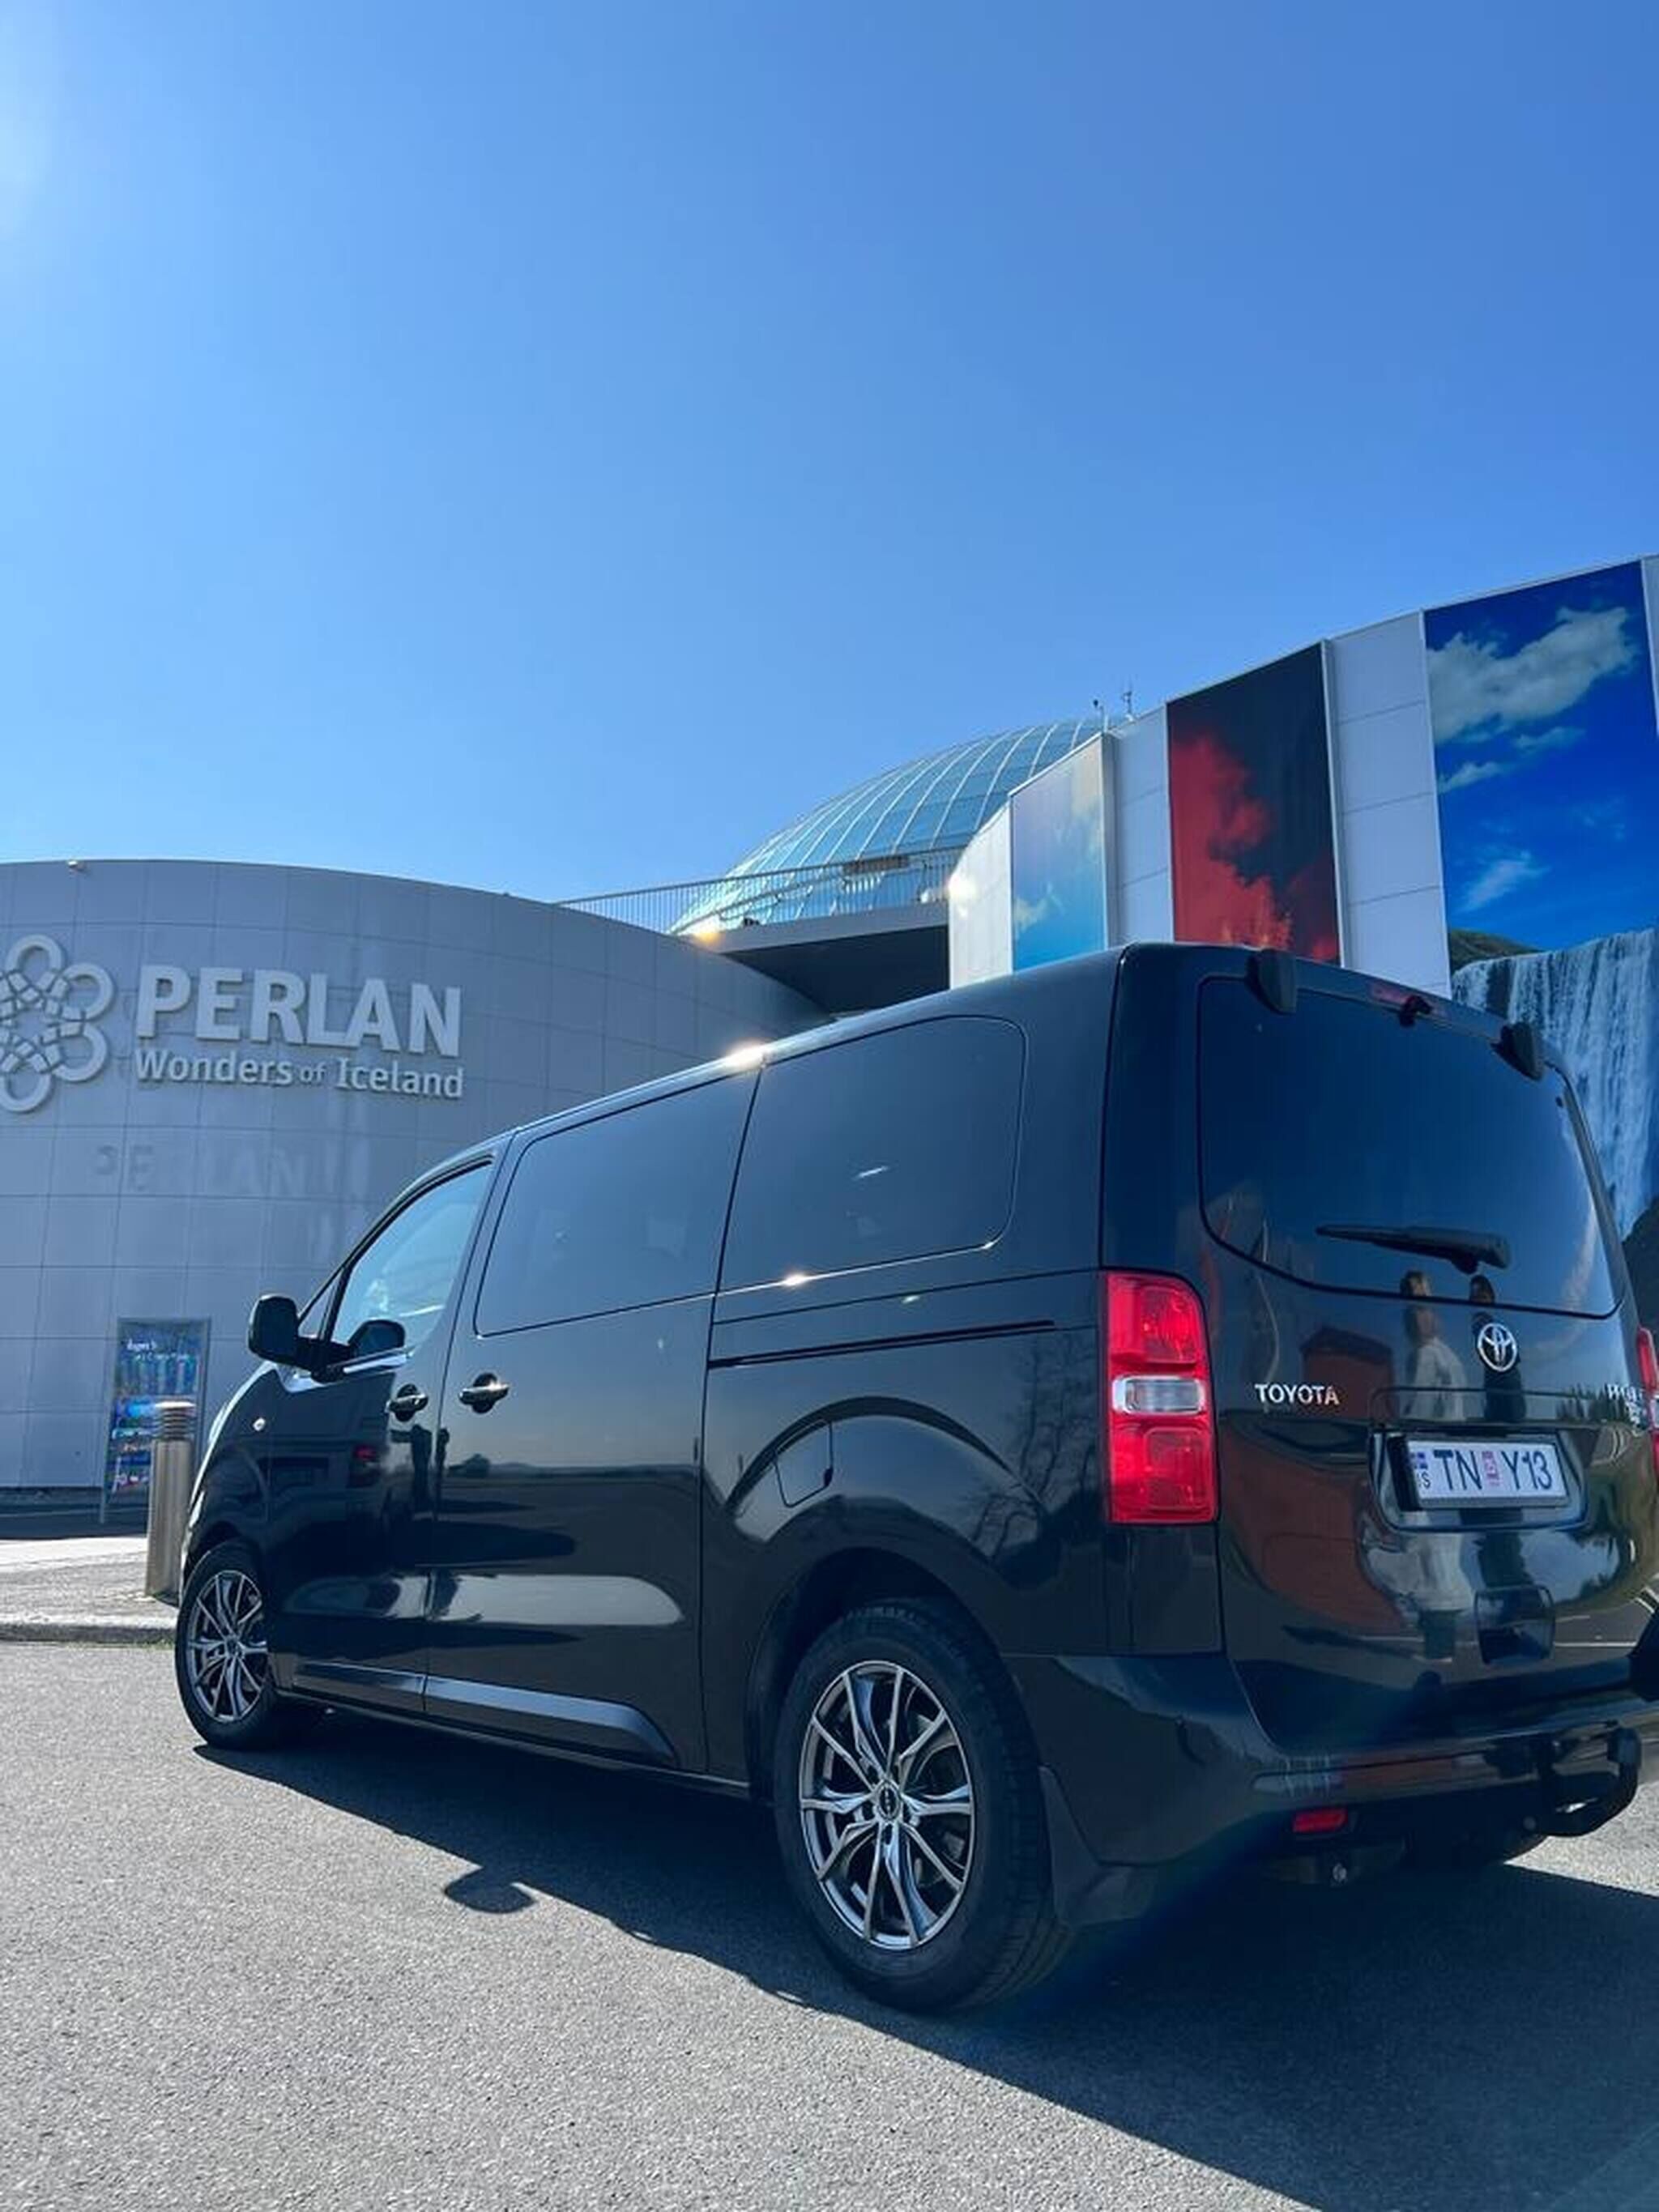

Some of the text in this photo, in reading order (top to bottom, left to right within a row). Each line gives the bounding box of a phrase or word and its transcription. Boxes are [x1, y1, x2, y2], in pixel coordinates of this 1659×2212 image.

[135, 965, 462, 1056] PERLAN
[135, 1051, 464, 1099] Wonders of Iceland
[1255, 1383, 1340, 1405] TOYOTA
[1433, 1449, 1482, 1490] TN
[1501, 1451, 1553, 1490] Y13
